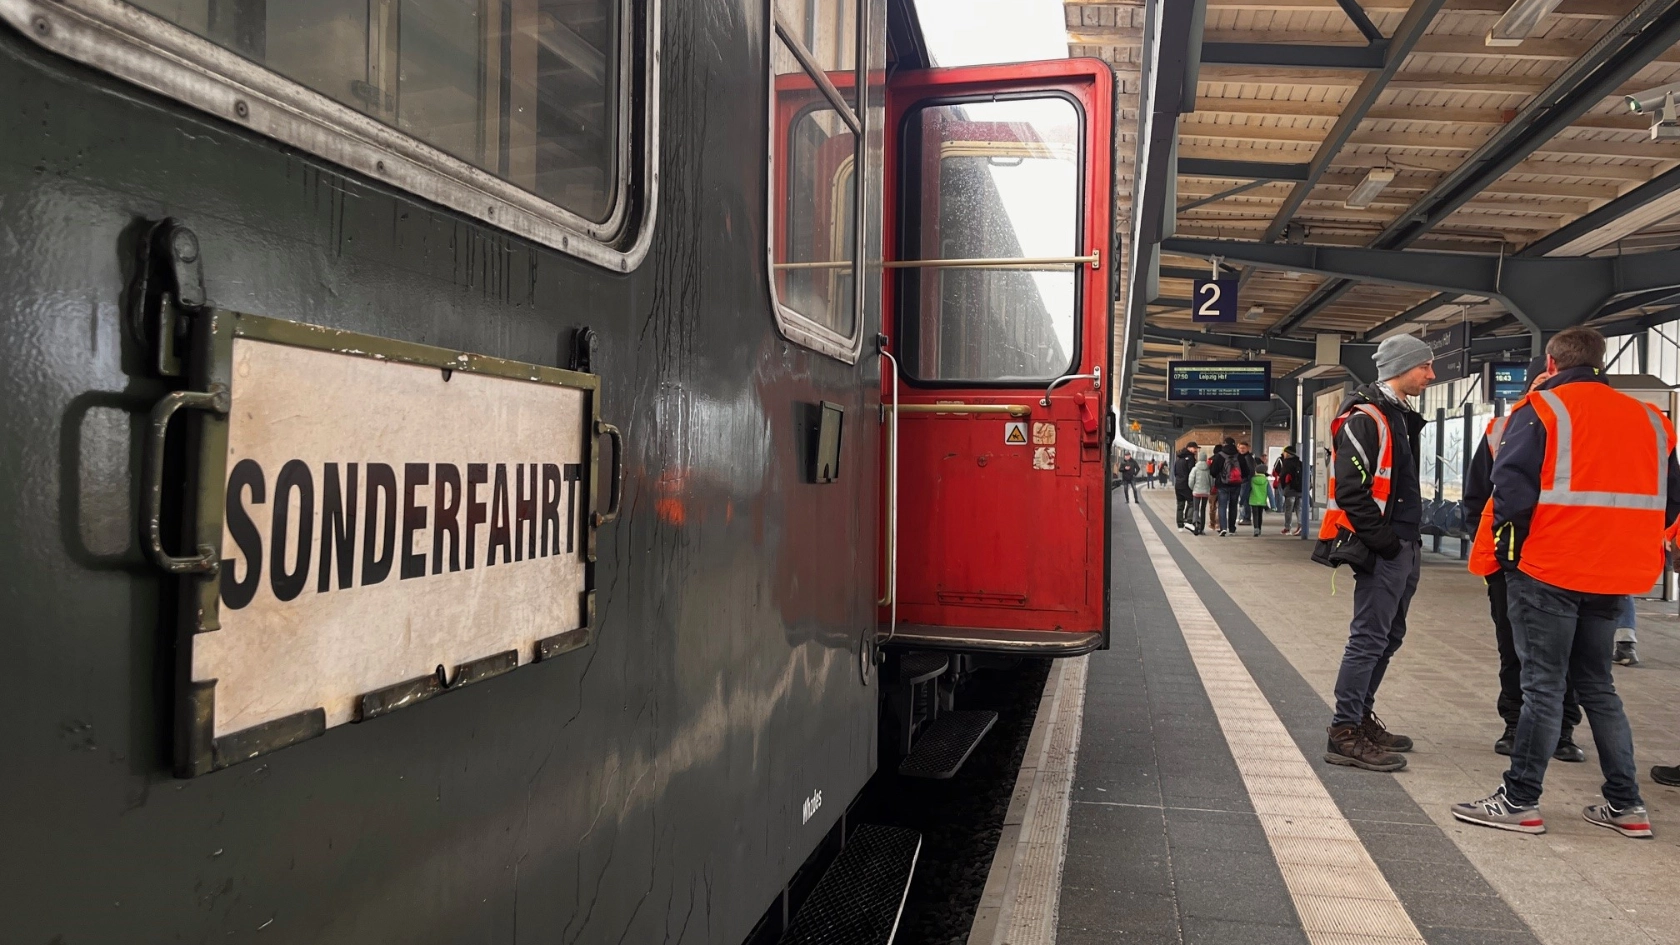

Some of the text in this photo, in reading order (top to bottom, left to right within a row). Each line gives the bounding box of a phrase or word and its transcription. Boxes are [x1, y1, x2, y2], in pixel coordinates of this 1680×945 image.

[1198, 283, 1221, 316] 2
[1199, 373, 1217, 381] Leipzig
[220, 458, 581, 610] SONDERFAHRT
[1484, 801, 1504, 817] N
